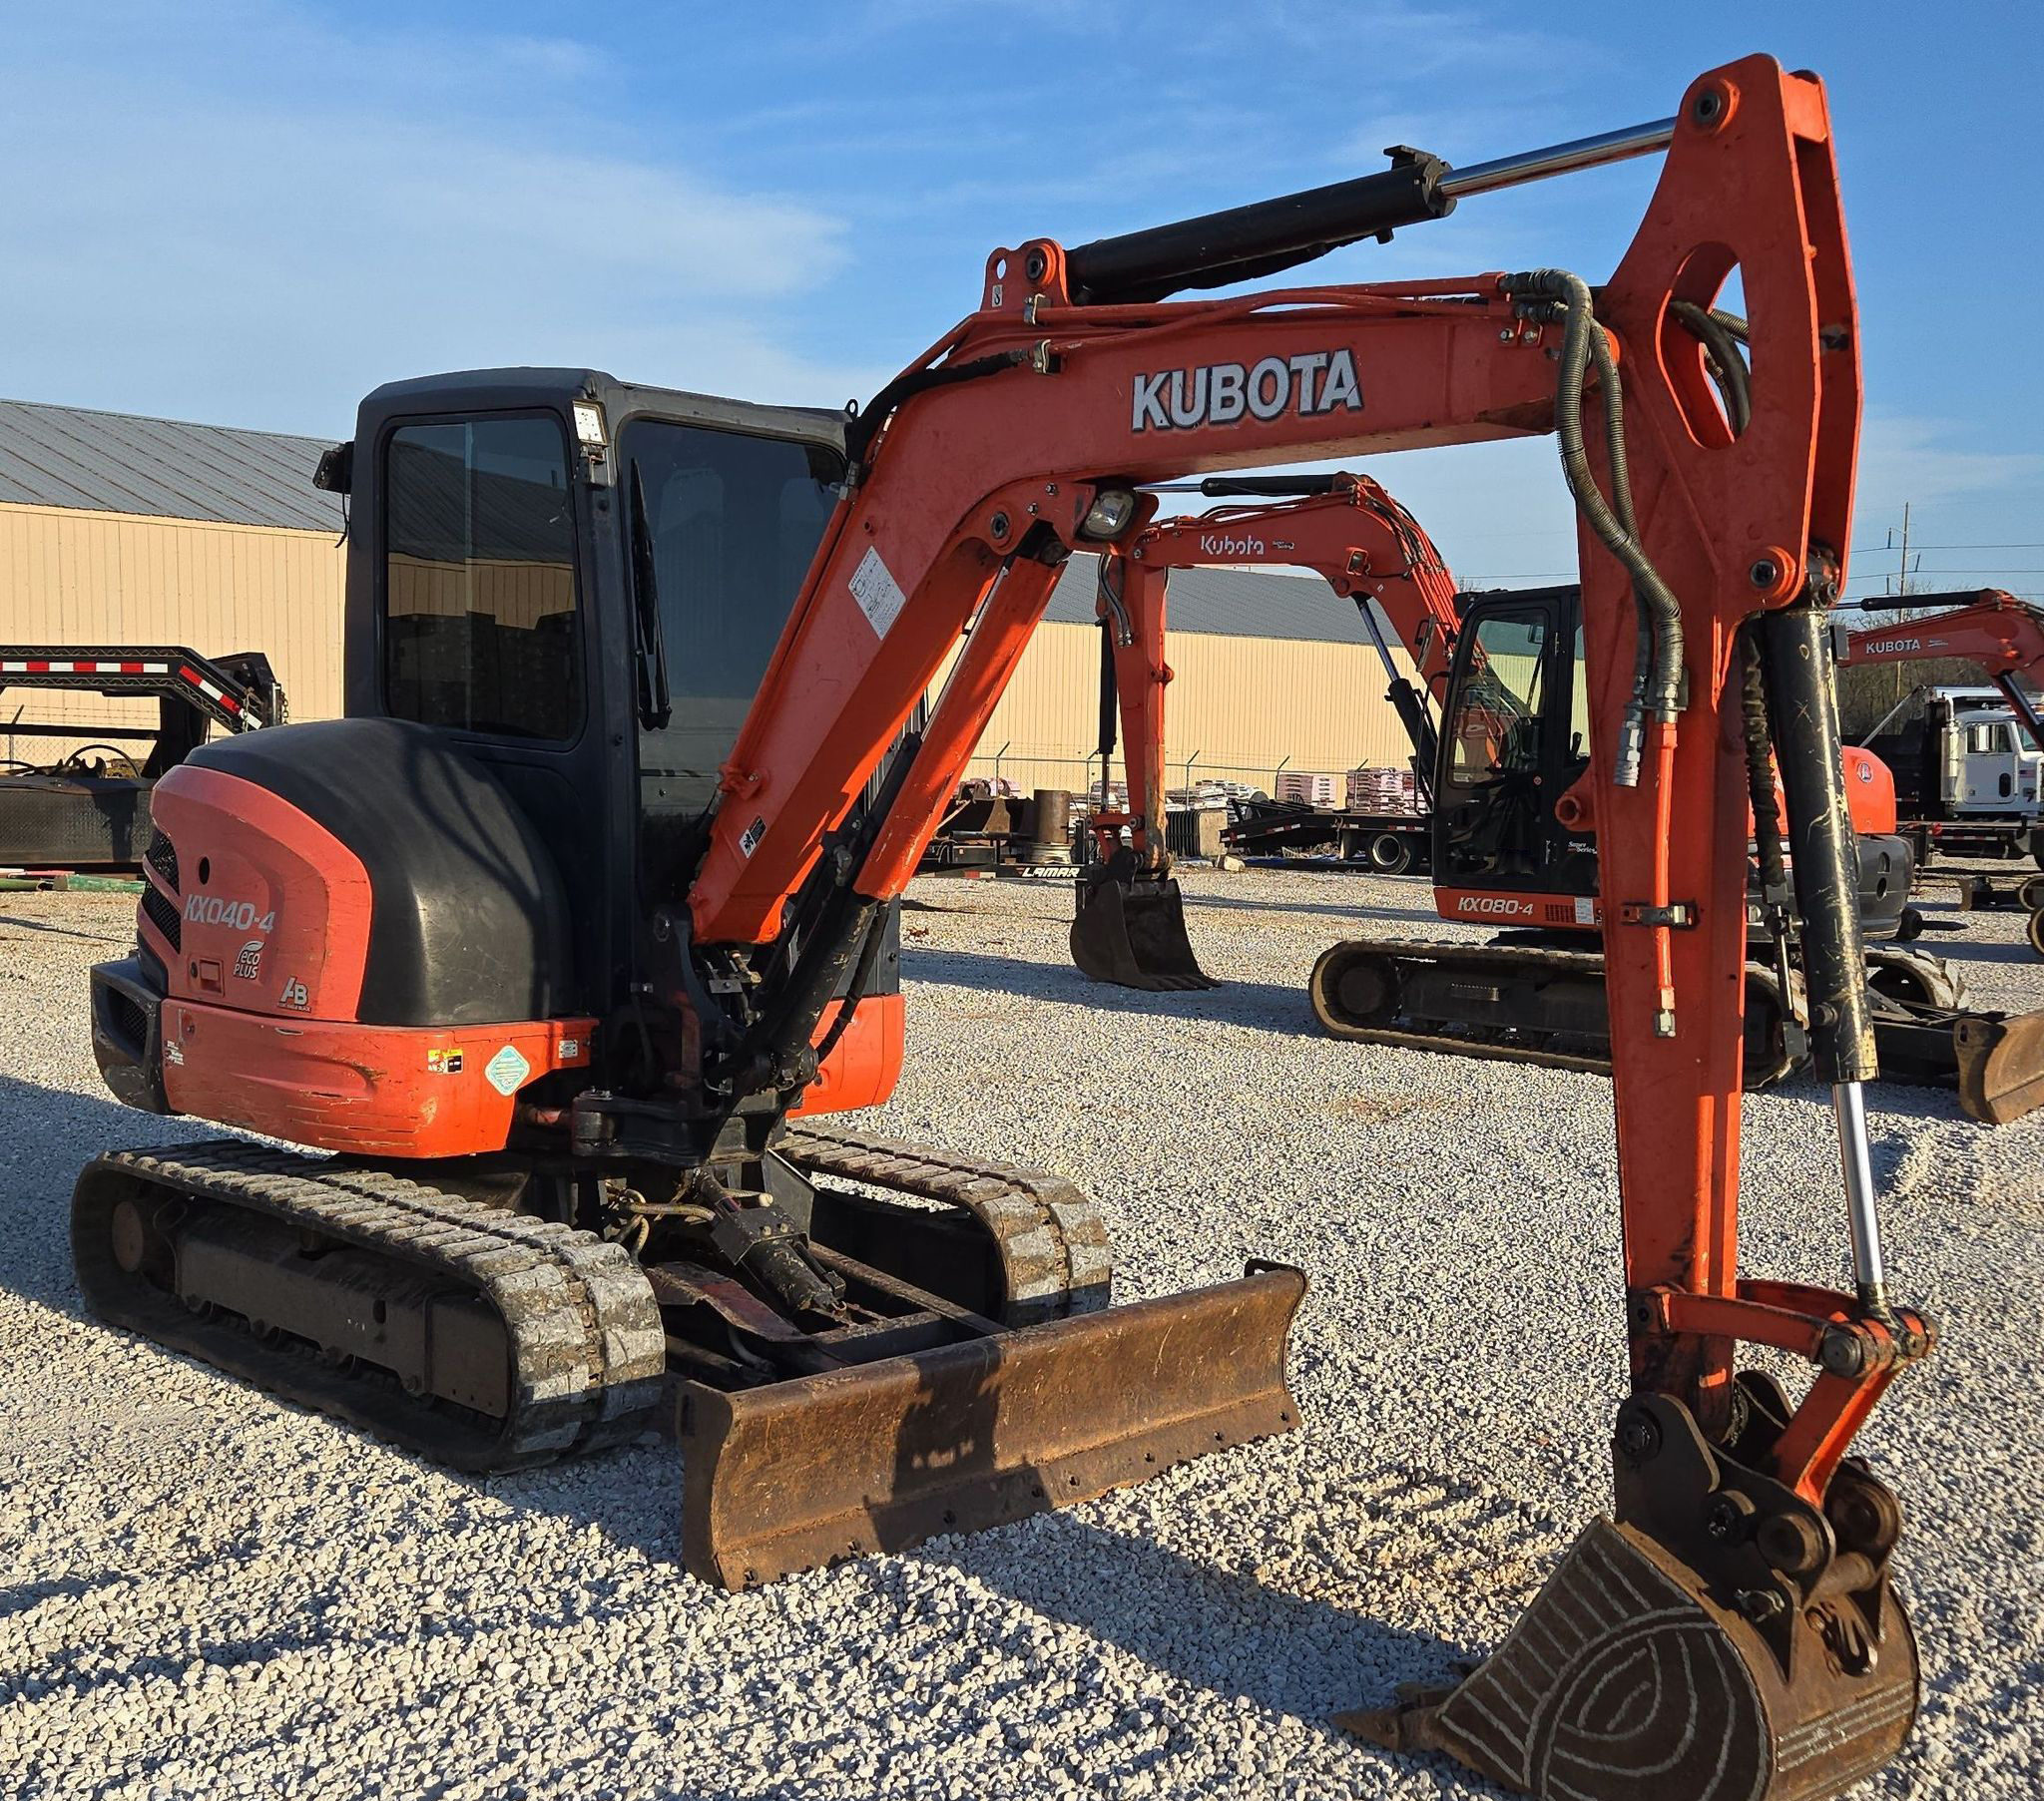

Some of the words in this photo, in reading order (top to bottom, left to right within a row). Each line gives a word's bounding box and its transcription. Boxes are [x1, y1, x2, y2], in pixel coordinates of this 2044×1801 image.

[1132, 349, 1363, 431] KUBOTA
[1200, 535, 1265, 555] Kubota
[1865, 639, 1921, 655] KUBOTA
[1021, 866, 1081, 878] LAMAR
[183, 894, 276, 934] KX040-4
[1457, 897, 1534, 916] KX080-4
[241, 950, 260, 966] eco
[233, 963, 258, 979] PLUS
[279, 976, 308, 1006] AB
